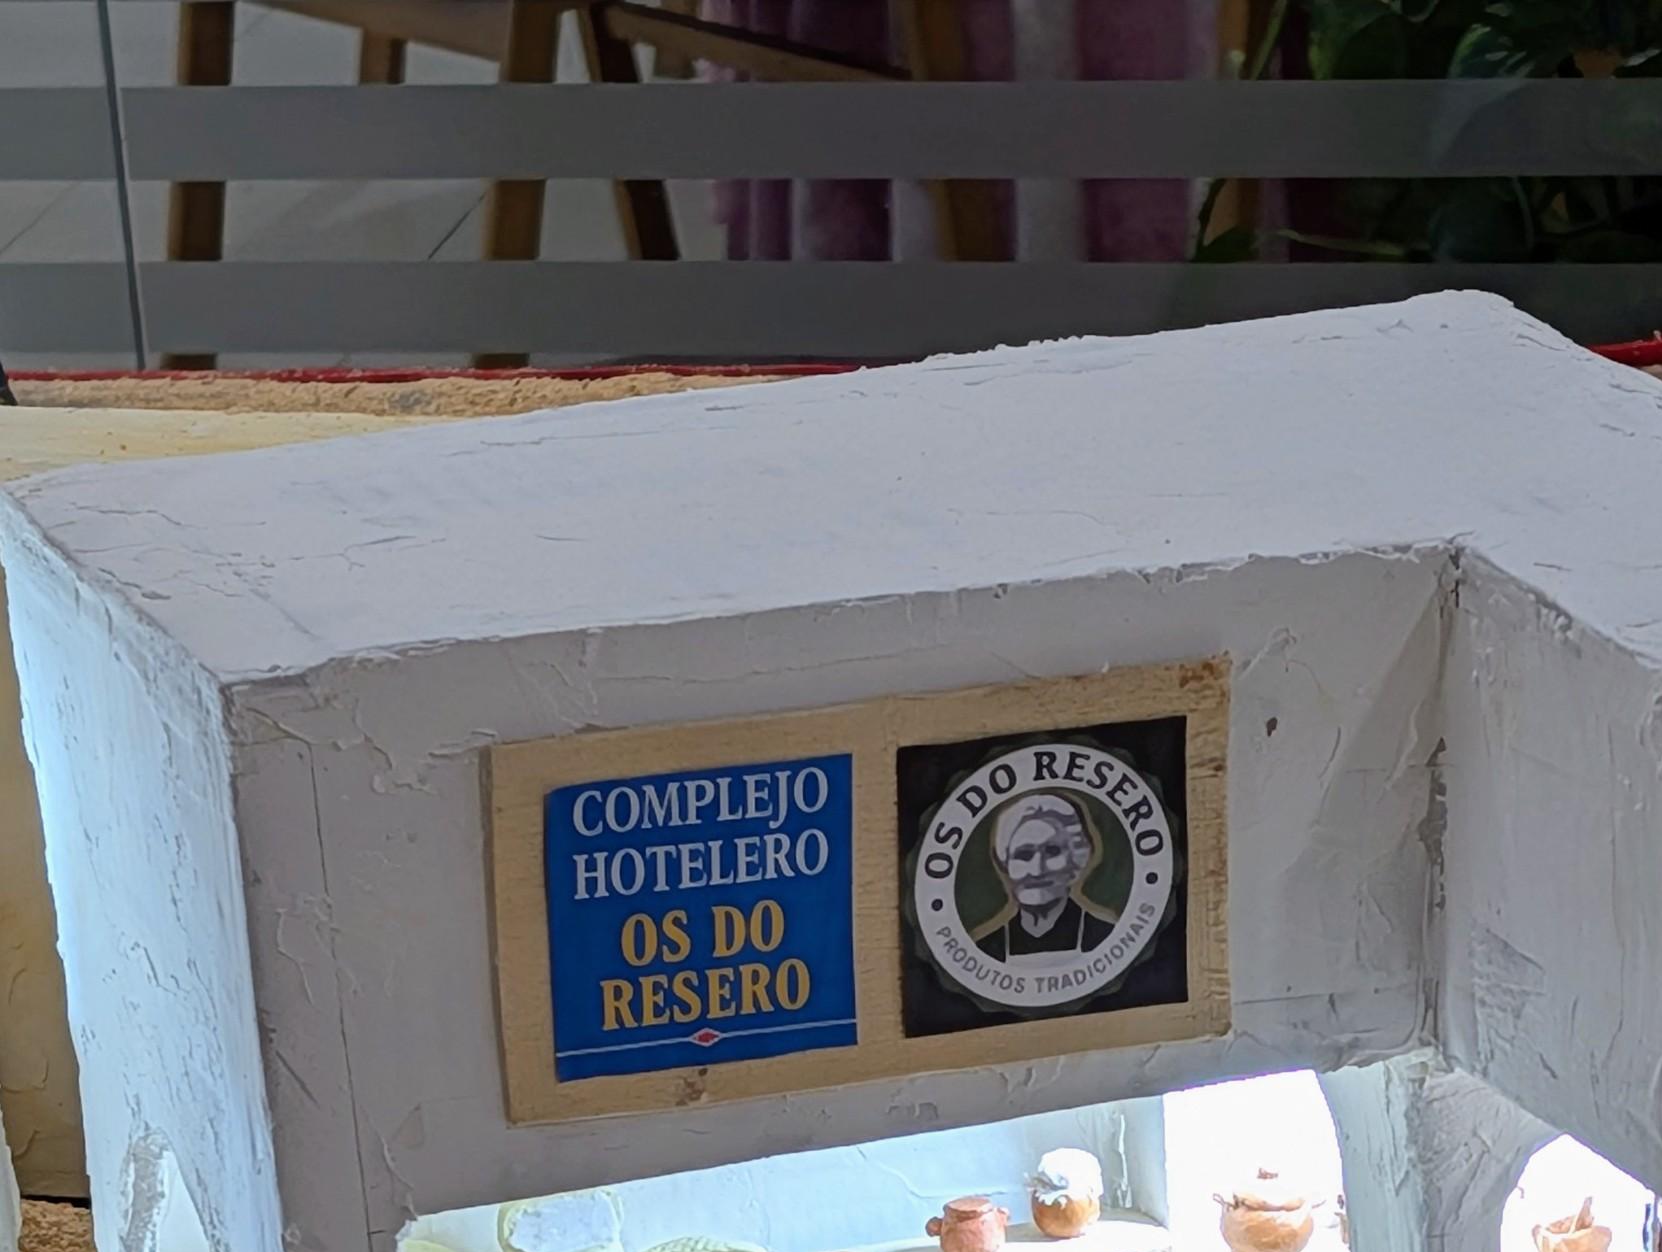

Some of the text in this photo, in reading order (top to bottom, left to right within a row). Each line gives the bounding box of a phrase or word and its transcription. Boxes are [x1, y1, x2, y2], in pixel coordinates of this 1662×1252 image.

[572, 766, 829, 837] COMPLEJO
[924, 750, 1165, 880] OS DO RESERO
[572, 828, 829, 900] HOTELERO
[620, 899, 785, 967] OS DO
[935, 901, 1156, 994] PRODUTOS TRADICIONAIS
[599, 957, 811, 1031] RESERO
